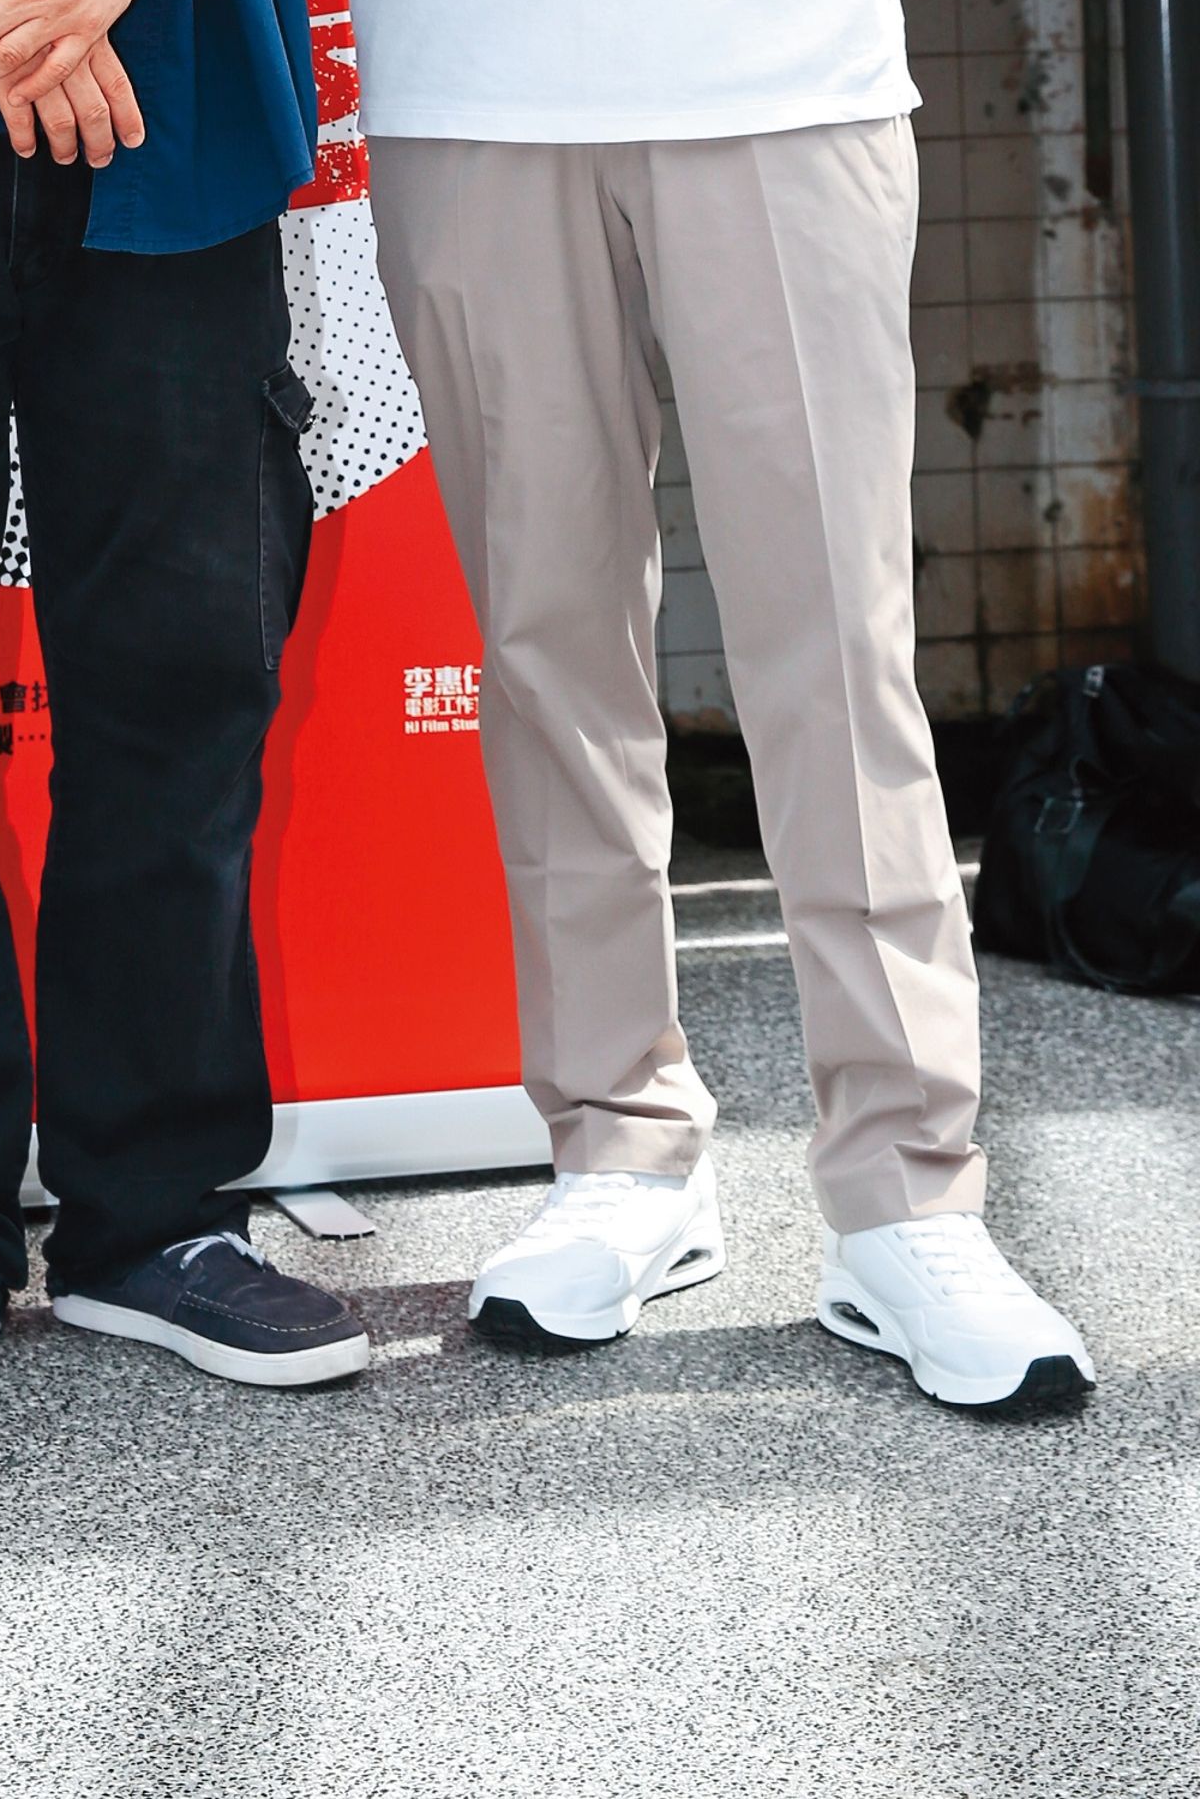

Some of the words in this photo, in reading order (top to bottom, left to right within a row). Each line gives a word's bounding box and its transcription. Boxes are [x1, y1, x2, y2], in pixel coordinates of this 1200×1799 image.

[403, 664, 482, 698] 李惠仁
[405, 695, 480, 718] 電影工作
[421, 719, 450, 734] Film
